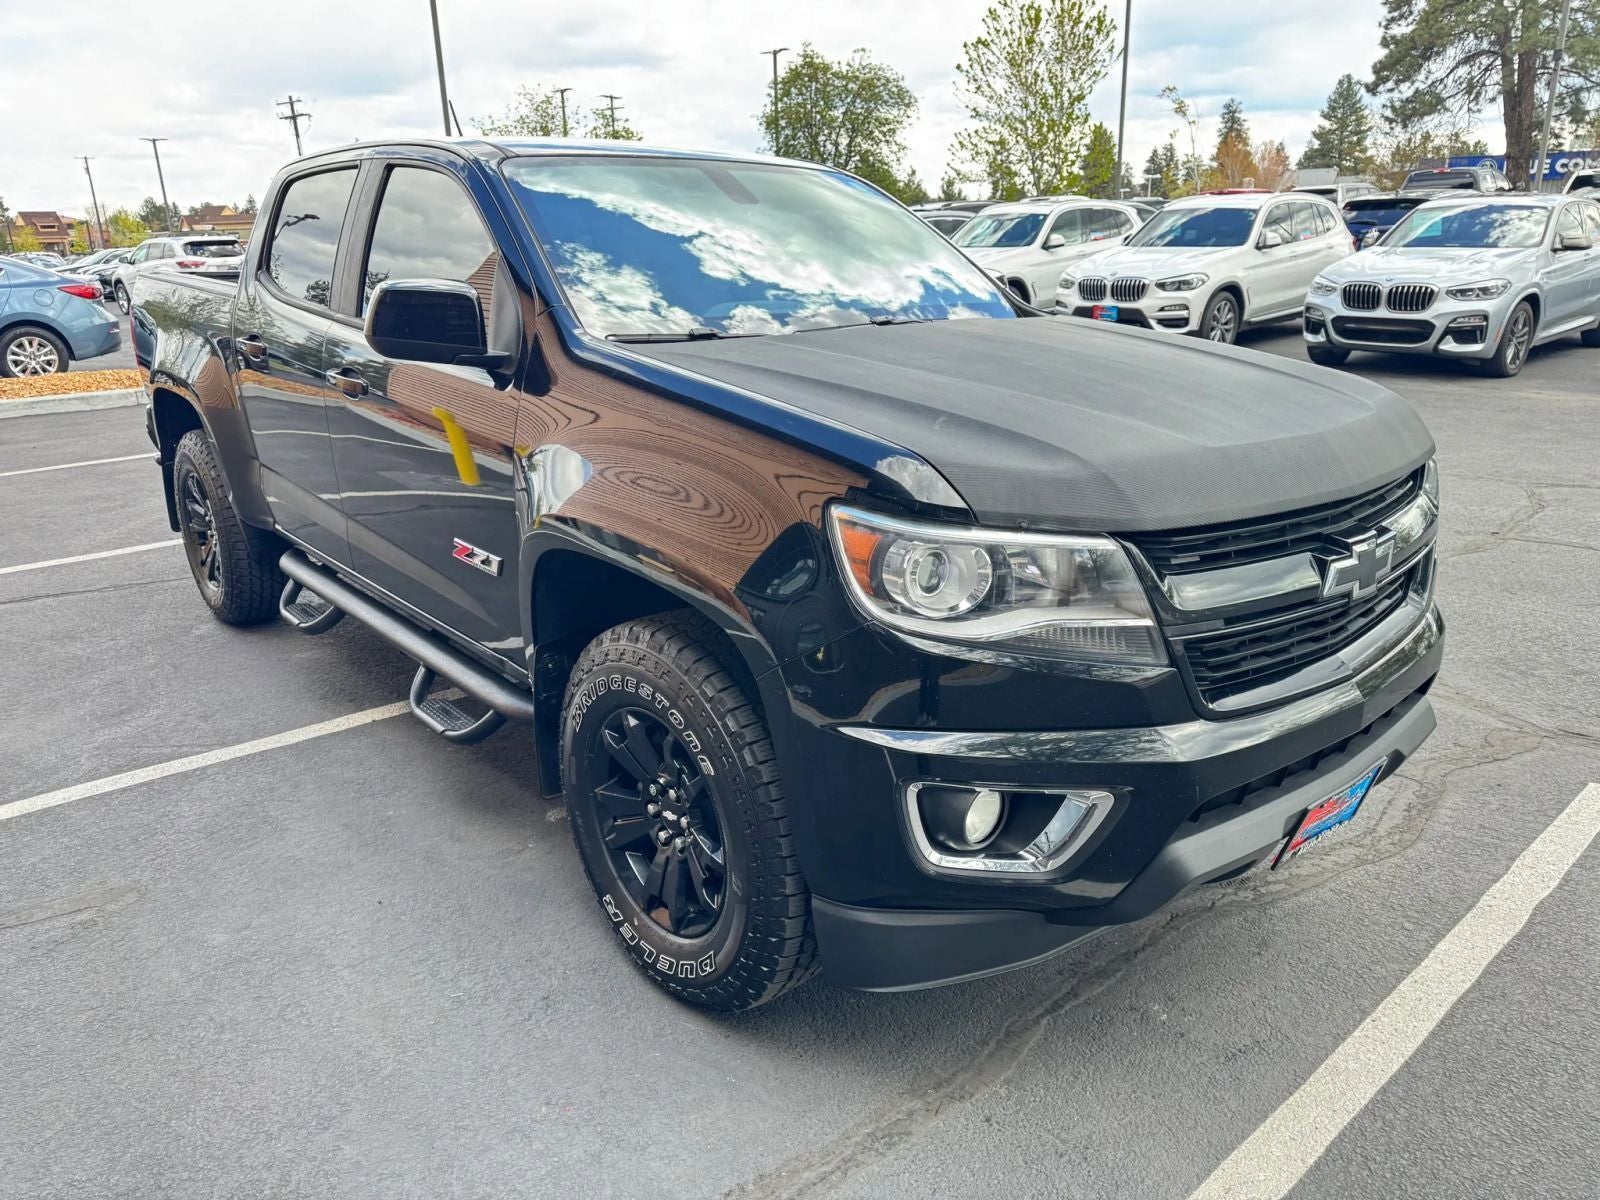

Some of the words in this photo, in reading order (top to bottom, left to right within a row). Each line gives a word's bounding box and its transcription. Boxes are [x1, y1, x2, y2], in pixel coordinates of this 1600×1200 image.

[453, 537, 503, 577] Z71
[572, 674, 715, 776] BRIDGESTONE
[602, 894, 716, 978] DUELER
